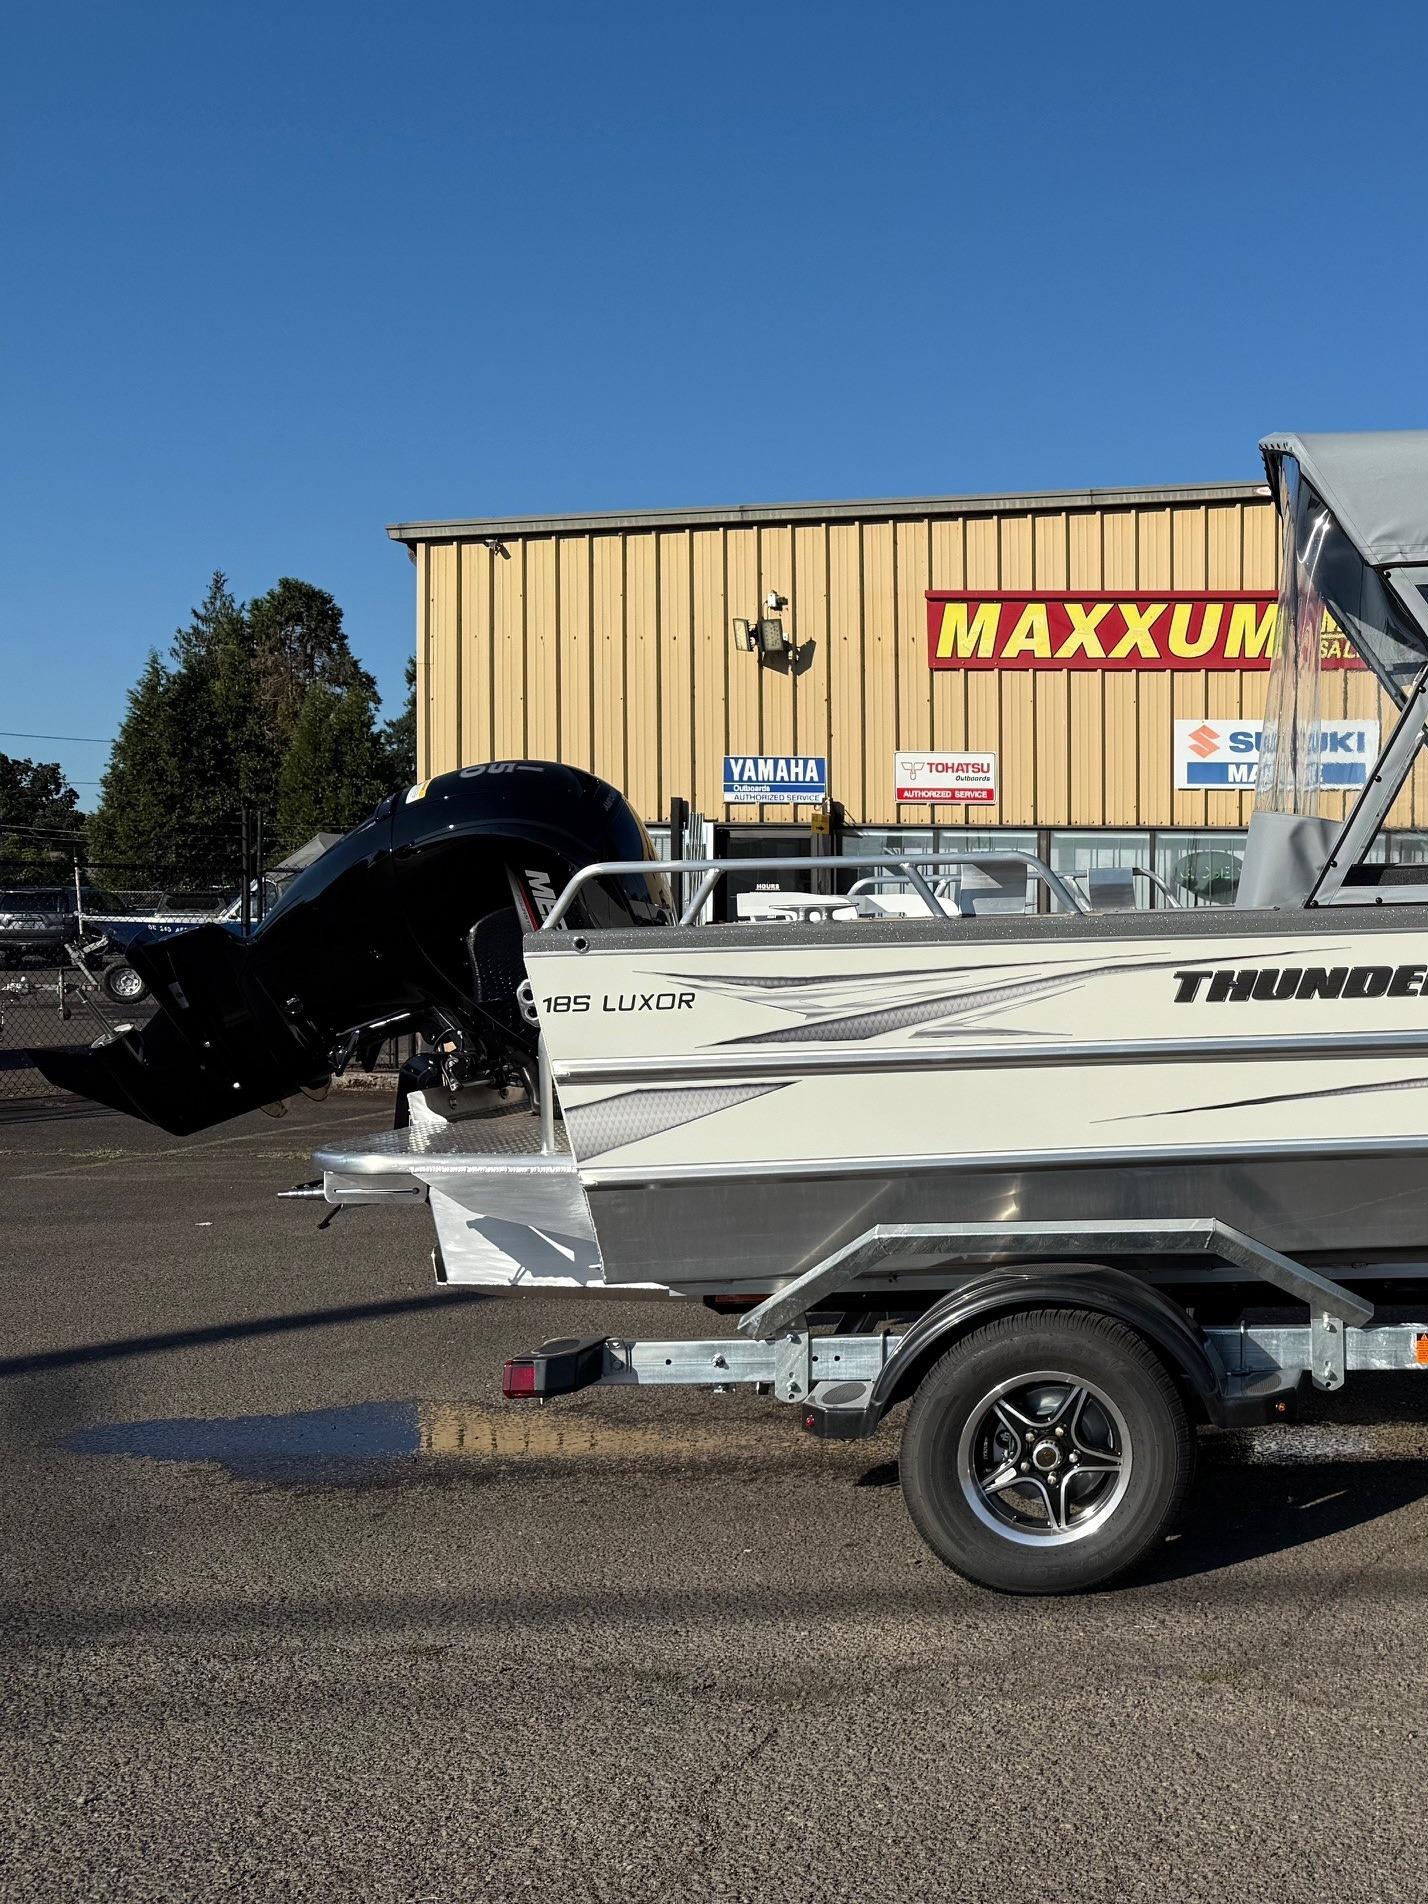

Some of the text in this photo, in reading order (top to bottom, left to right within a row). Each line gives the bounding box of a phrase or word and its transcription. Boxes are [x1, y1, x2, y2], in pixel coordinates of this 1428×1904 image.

[935, 602, 1282, 659] MAXXUM
[1320, 639, 1361, 659] SAL
[1228, 731, 1366, 754] SUUKI
[729, 758, 819, 782] YAMAHA
[927, 762, 991, 774] TOHATSU
[733, 784, 771, 793] Outboards
[903, 790, 988, 799] AUTHORIZED SERVICE
[734, 794, 820, 802] AUTHORIZED SERVICE
[756, 883, 780, 891] HOURS
[543, 993, 695, 1013] 185 LUXOR
